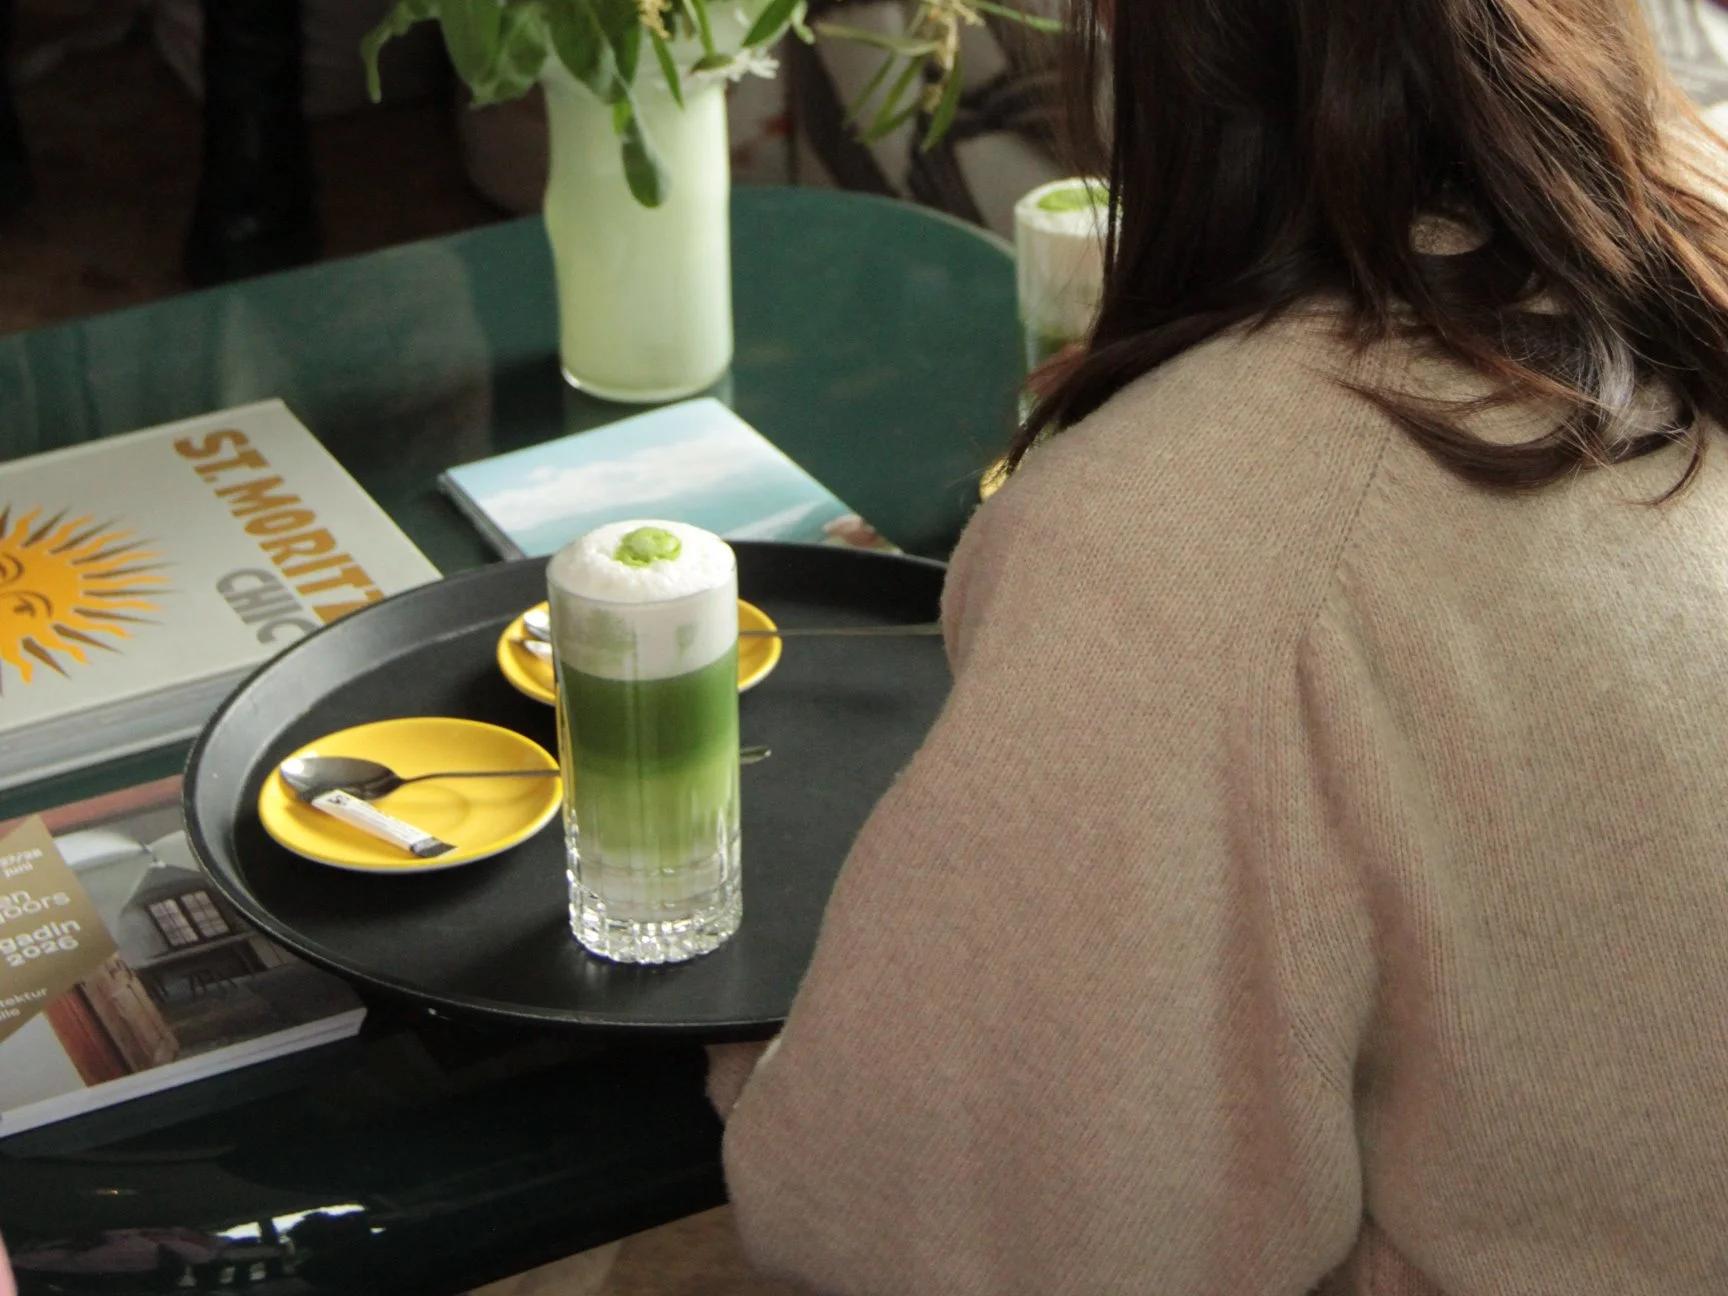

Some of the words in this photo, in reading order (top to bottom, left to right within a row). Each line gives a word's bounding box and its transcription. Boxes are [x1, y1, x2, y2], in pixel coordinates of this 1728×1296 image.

[173, 428, 271, 483] ST.
[216, 568, 319, 644] CHIC
[0, 891, 71, 925] oors
[5, 935, 79, 968] 2026
